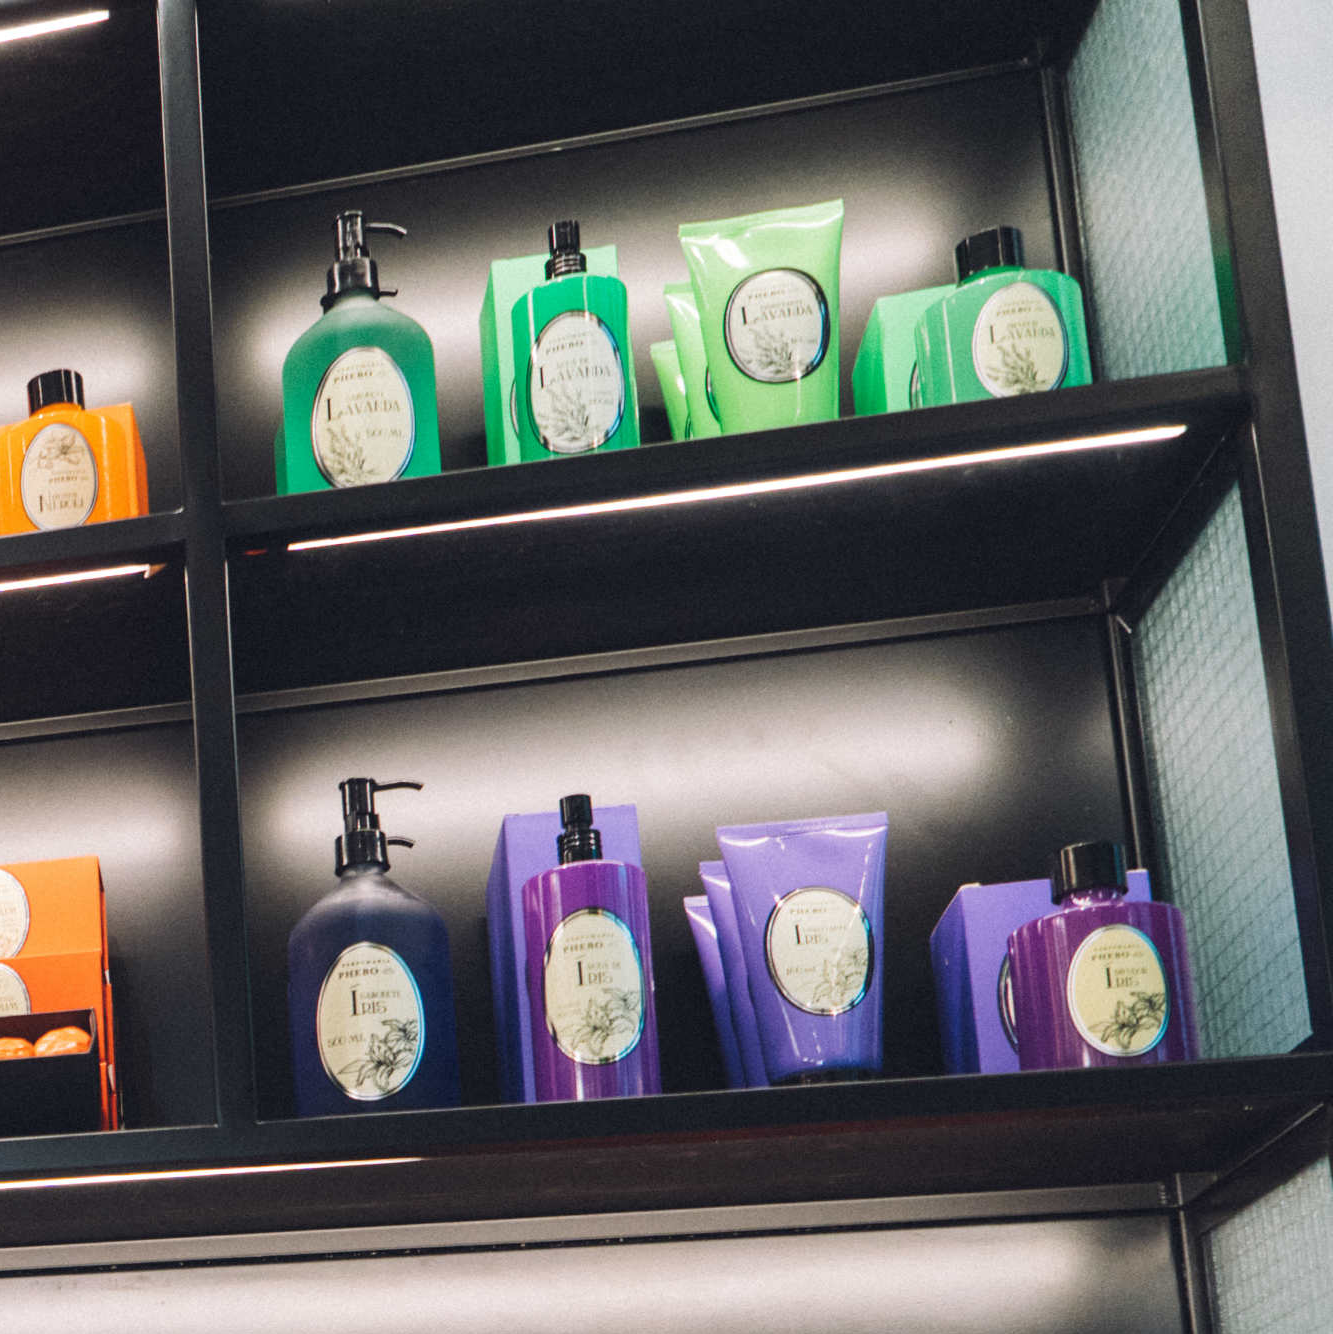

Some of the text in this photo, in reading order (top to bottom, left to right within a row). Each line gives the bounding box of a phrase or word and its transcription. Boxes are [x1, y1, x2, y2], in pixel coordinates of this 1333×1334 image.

[740, 302, 815, 326] LAVANDA
[989, 323, 1058, 345] LAVANDA
[538, 365, 614, 390] LAVANDA
[325, 397, 402, 423] LAVANDA
[38, 494, 87, 514] NEROLI
[338, 968, 380, 980] PHEBO
